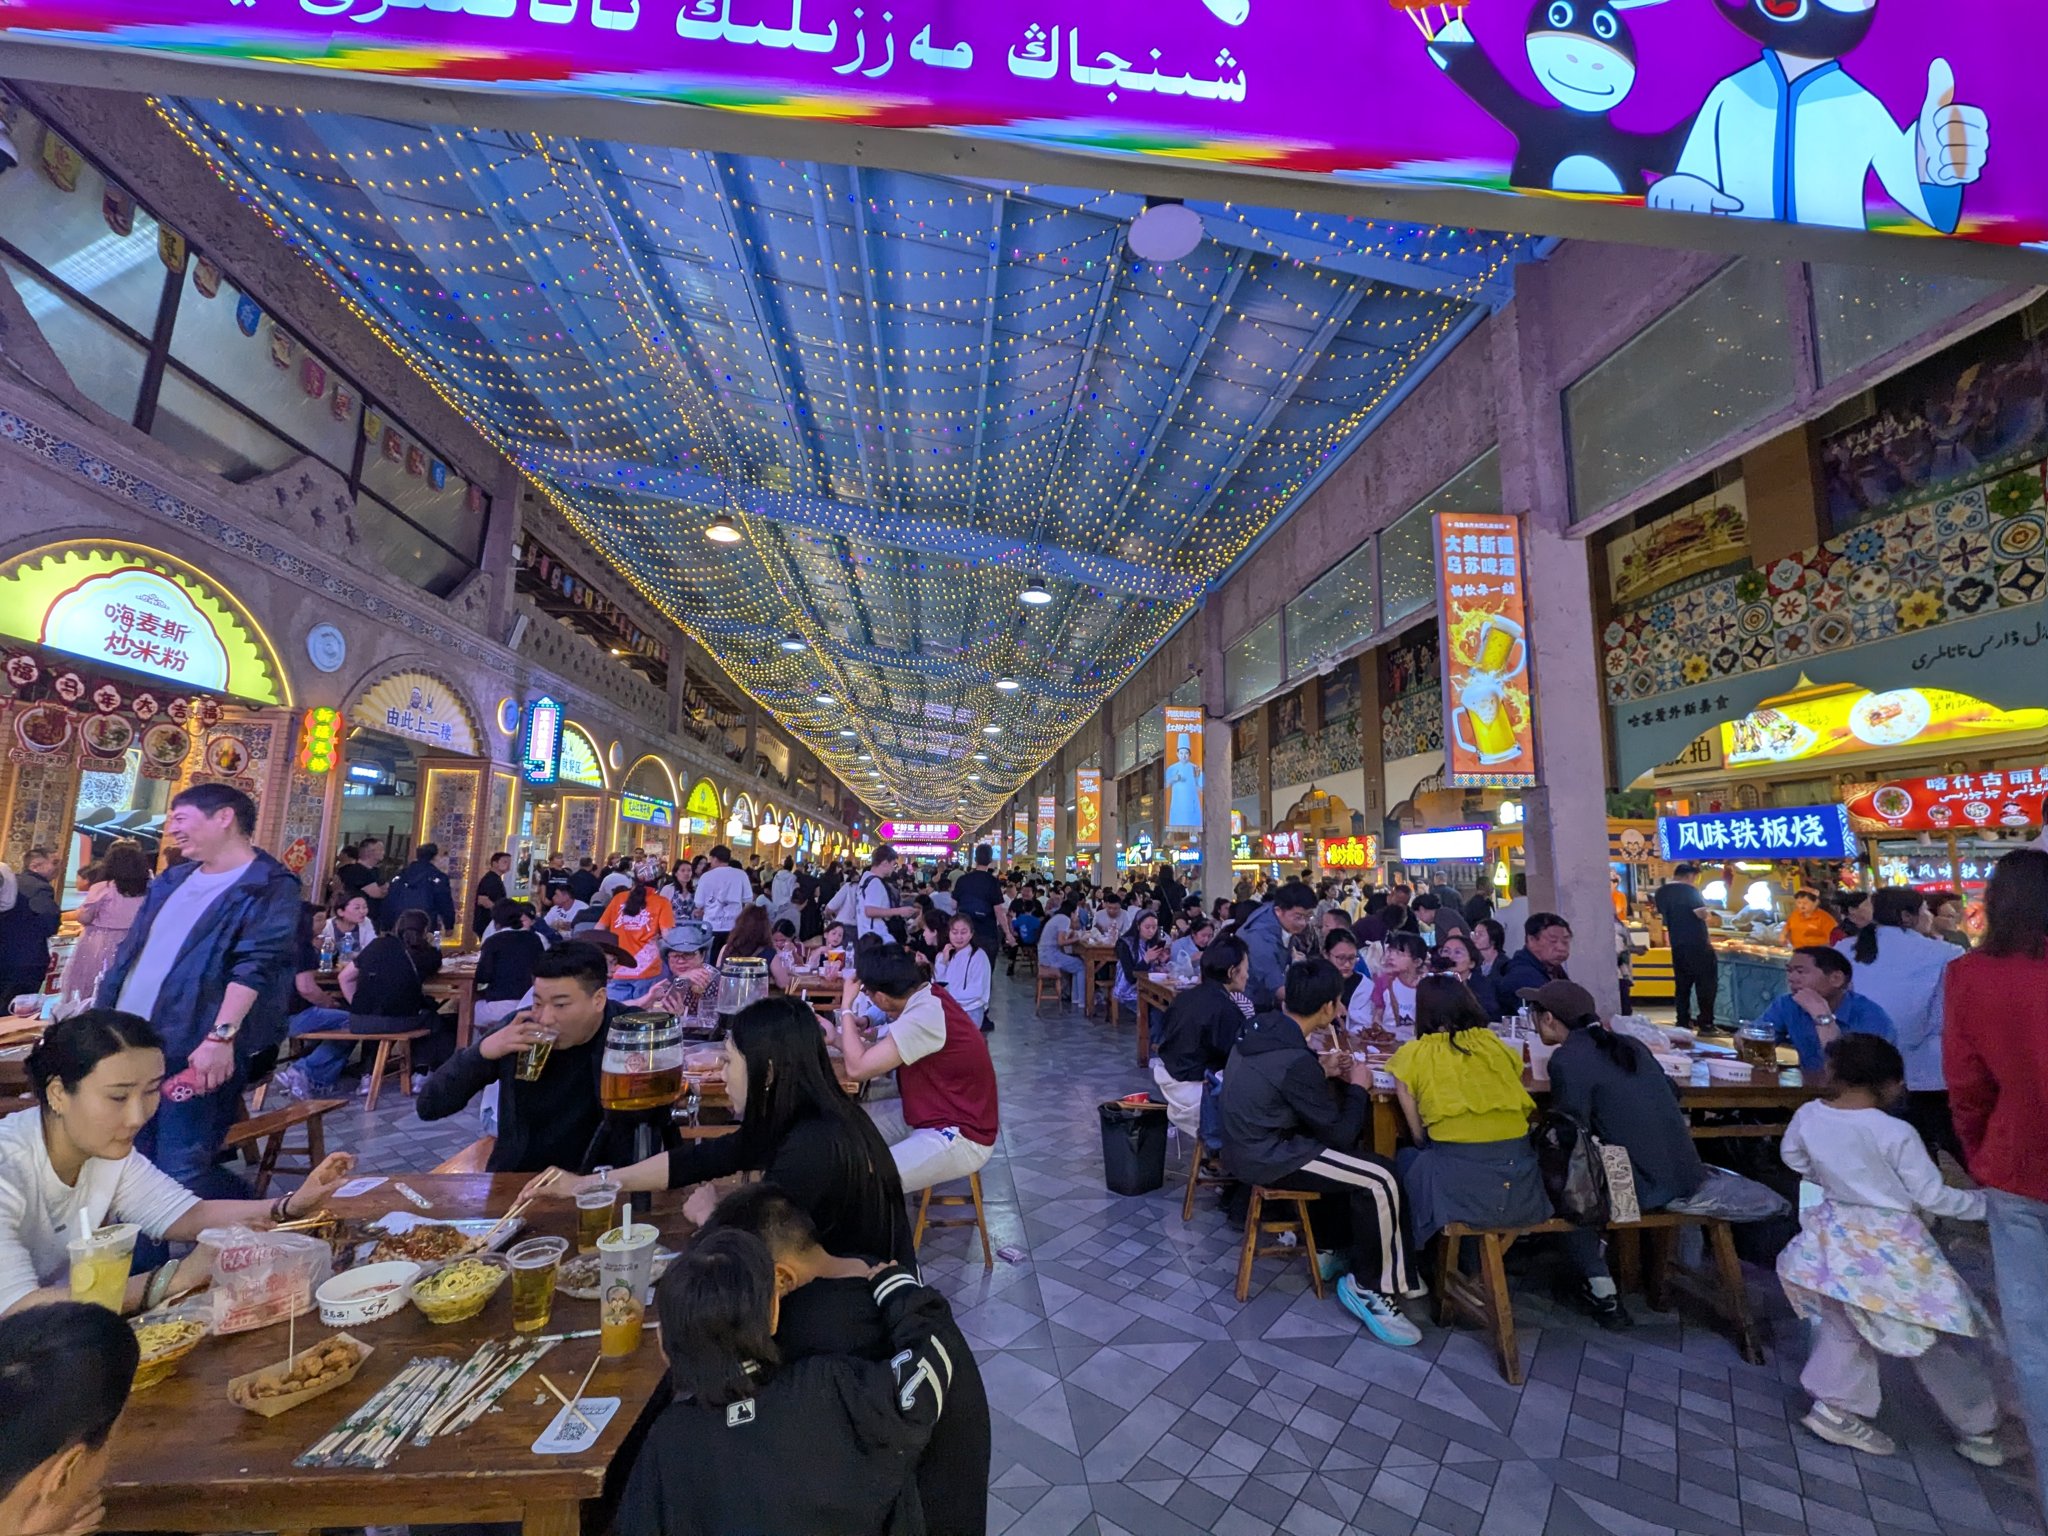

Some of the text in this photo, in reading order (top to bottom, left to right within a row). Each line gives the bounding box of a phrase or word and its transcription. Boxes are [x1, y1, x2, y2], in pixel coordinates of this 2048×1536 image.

[1445, 534, 1514, 554] 大美新疆
[1447, 555, 1515, 576] 乌苏啤酒
[104, 603, 193, 644] 嗨麦斯
[104, 630, 189, 672] 炒米粉
[387, 706, 453, 742] 由此上二楼
[1678, 814, 1827, 851] 风味铁板烧
